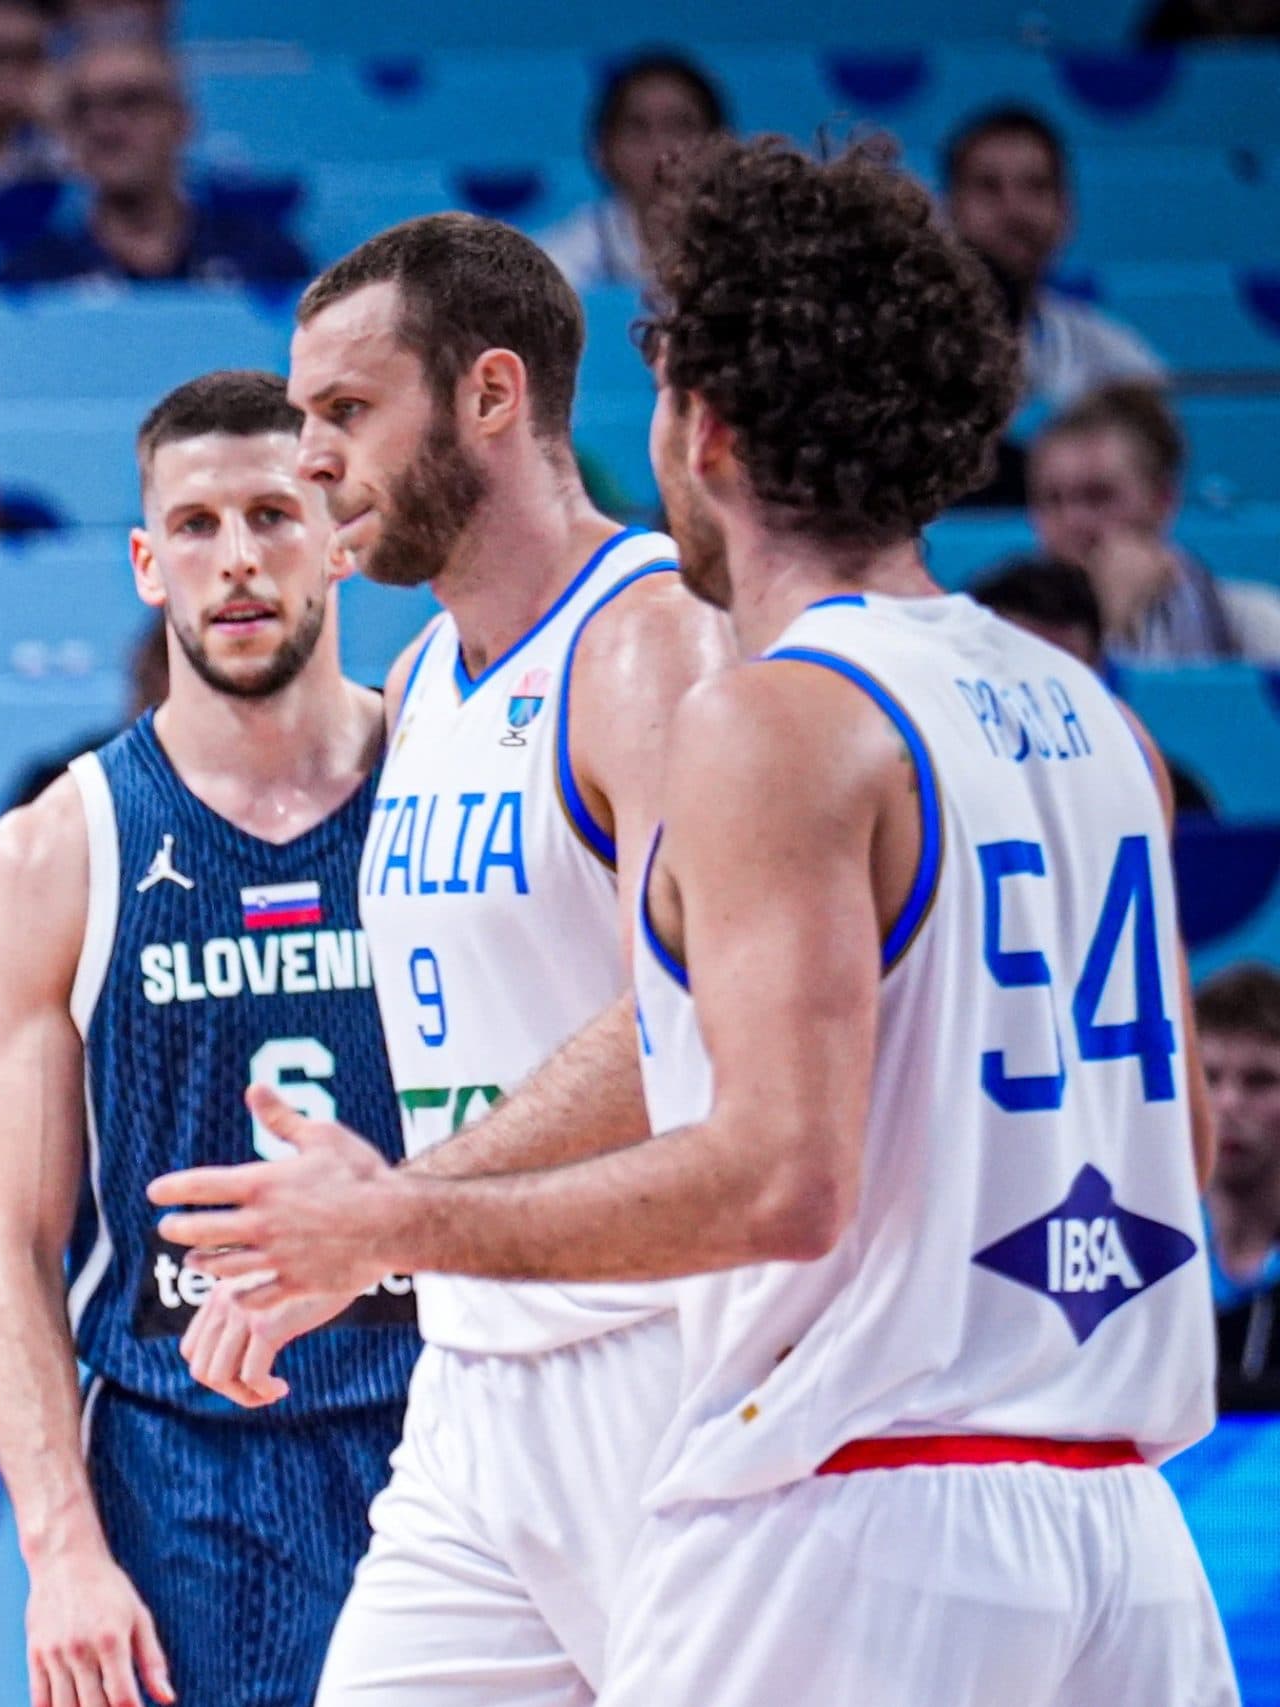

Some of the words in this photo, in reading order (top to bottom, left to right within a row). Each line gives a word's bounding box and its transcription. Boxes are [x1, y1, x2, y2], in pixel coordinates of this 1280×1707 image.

[365, 792, 529, 896] TALIA
[139, 930, 375, 1004] SLOVENI
[409, 947, 447, 1047] 9
[976, 834, 1176, 1113] 54
[249, 1036, 336, 1161] 6
[1047, 1217, 1143, 1293] IBSA
